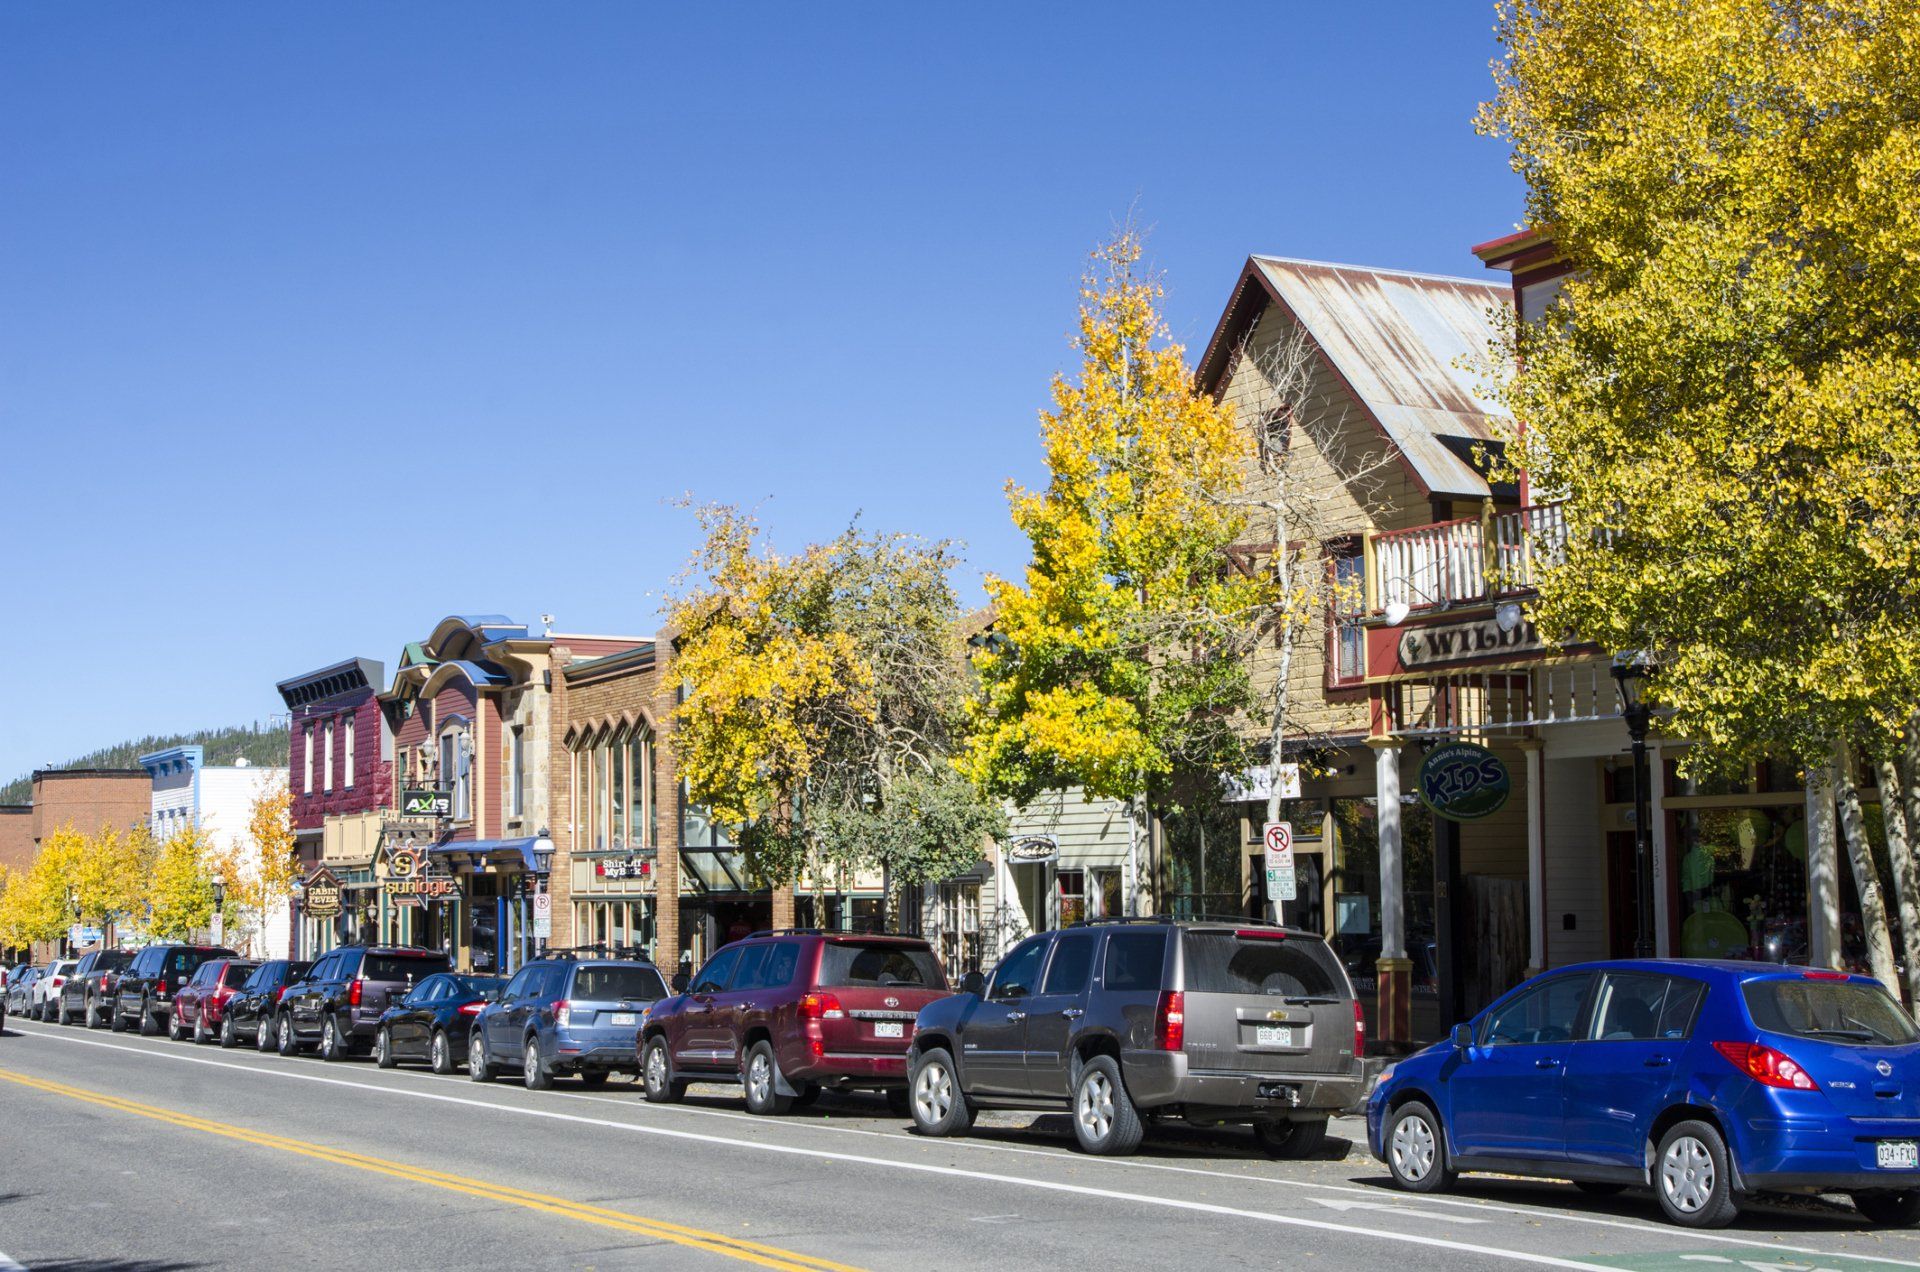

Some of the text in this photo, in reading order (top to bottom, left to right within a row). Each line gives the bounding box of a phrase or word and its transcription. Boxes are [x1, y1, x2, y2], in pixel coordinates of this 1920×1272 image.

[1427, 748, 1482, 769] Annie's Alpine
[1424, 756, 1503, 804] KIDS
[405, 794, 450, 812] AXIS
[394, 856, 411, 875] S
[1268, 870, 1275, 881] 3
[308, 887, 339, 895] CABIN
[385, 879, 453, 897] sunlogic
[308, 895, 339, 905] FEVER
[1828, 1081, 1857, 1089] VERSA
